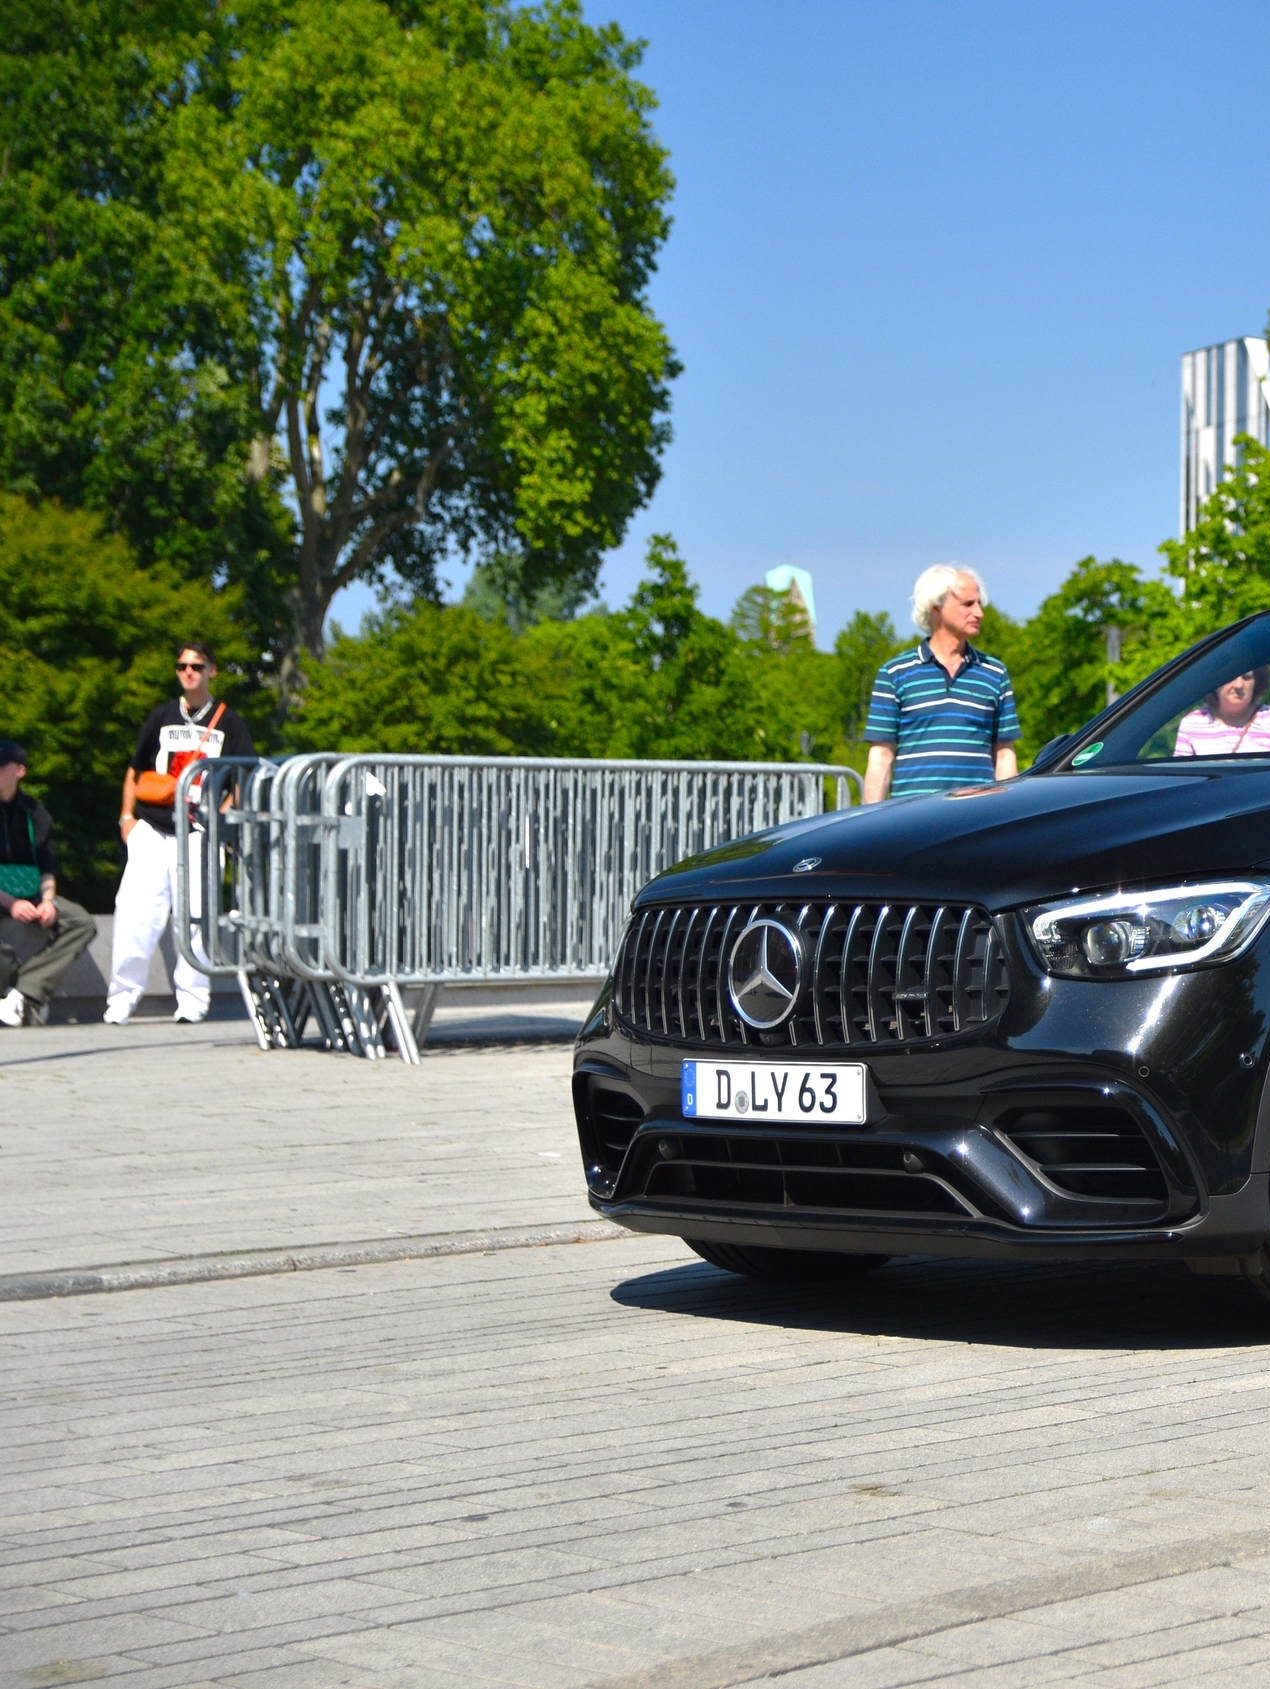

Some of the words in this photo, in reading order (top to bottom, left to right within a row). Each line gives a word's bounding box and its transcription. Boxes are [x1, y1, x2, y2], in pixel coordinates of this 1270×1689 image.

[687, 1093, 694, 1106] D
[716, 1069, 731, 1109] D
[751, 1071, 789, 1112] LY
[798, 1072, 838, 1114] 63
